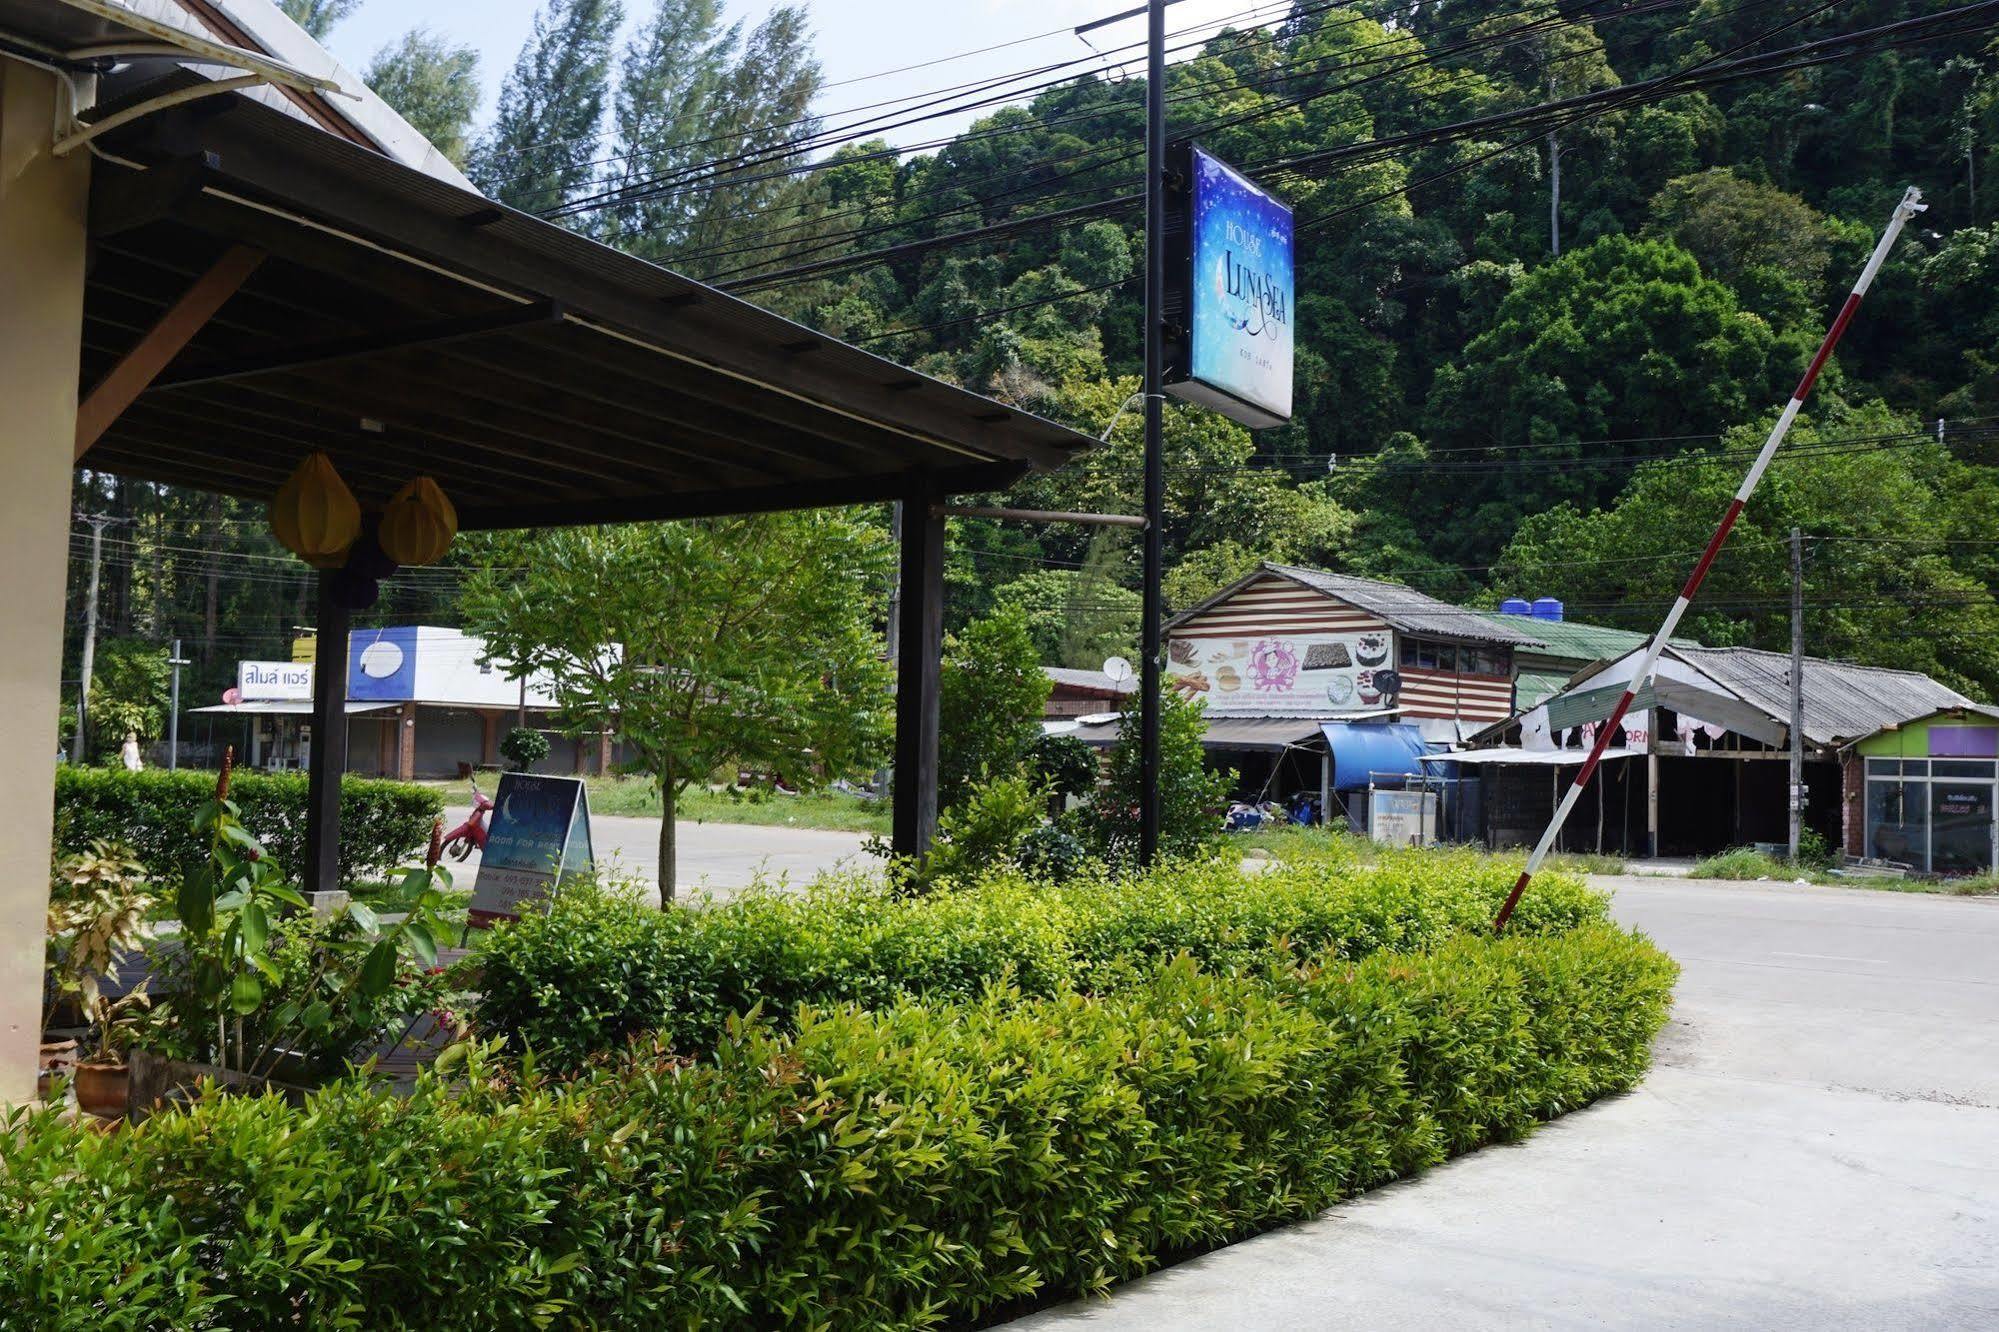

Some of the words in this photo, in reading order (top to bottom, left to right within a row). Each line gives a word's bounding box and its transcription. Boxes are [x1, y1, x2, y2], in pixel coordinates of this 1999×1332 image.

[1226, 220, 1262, 258] HOUSE
[245, 664, 278, 685] สไมล์
[283, 669, 309, 685] แอร์
[488, 835, 513, 846] ROOM
[516, 839, 534, 849] FOR
